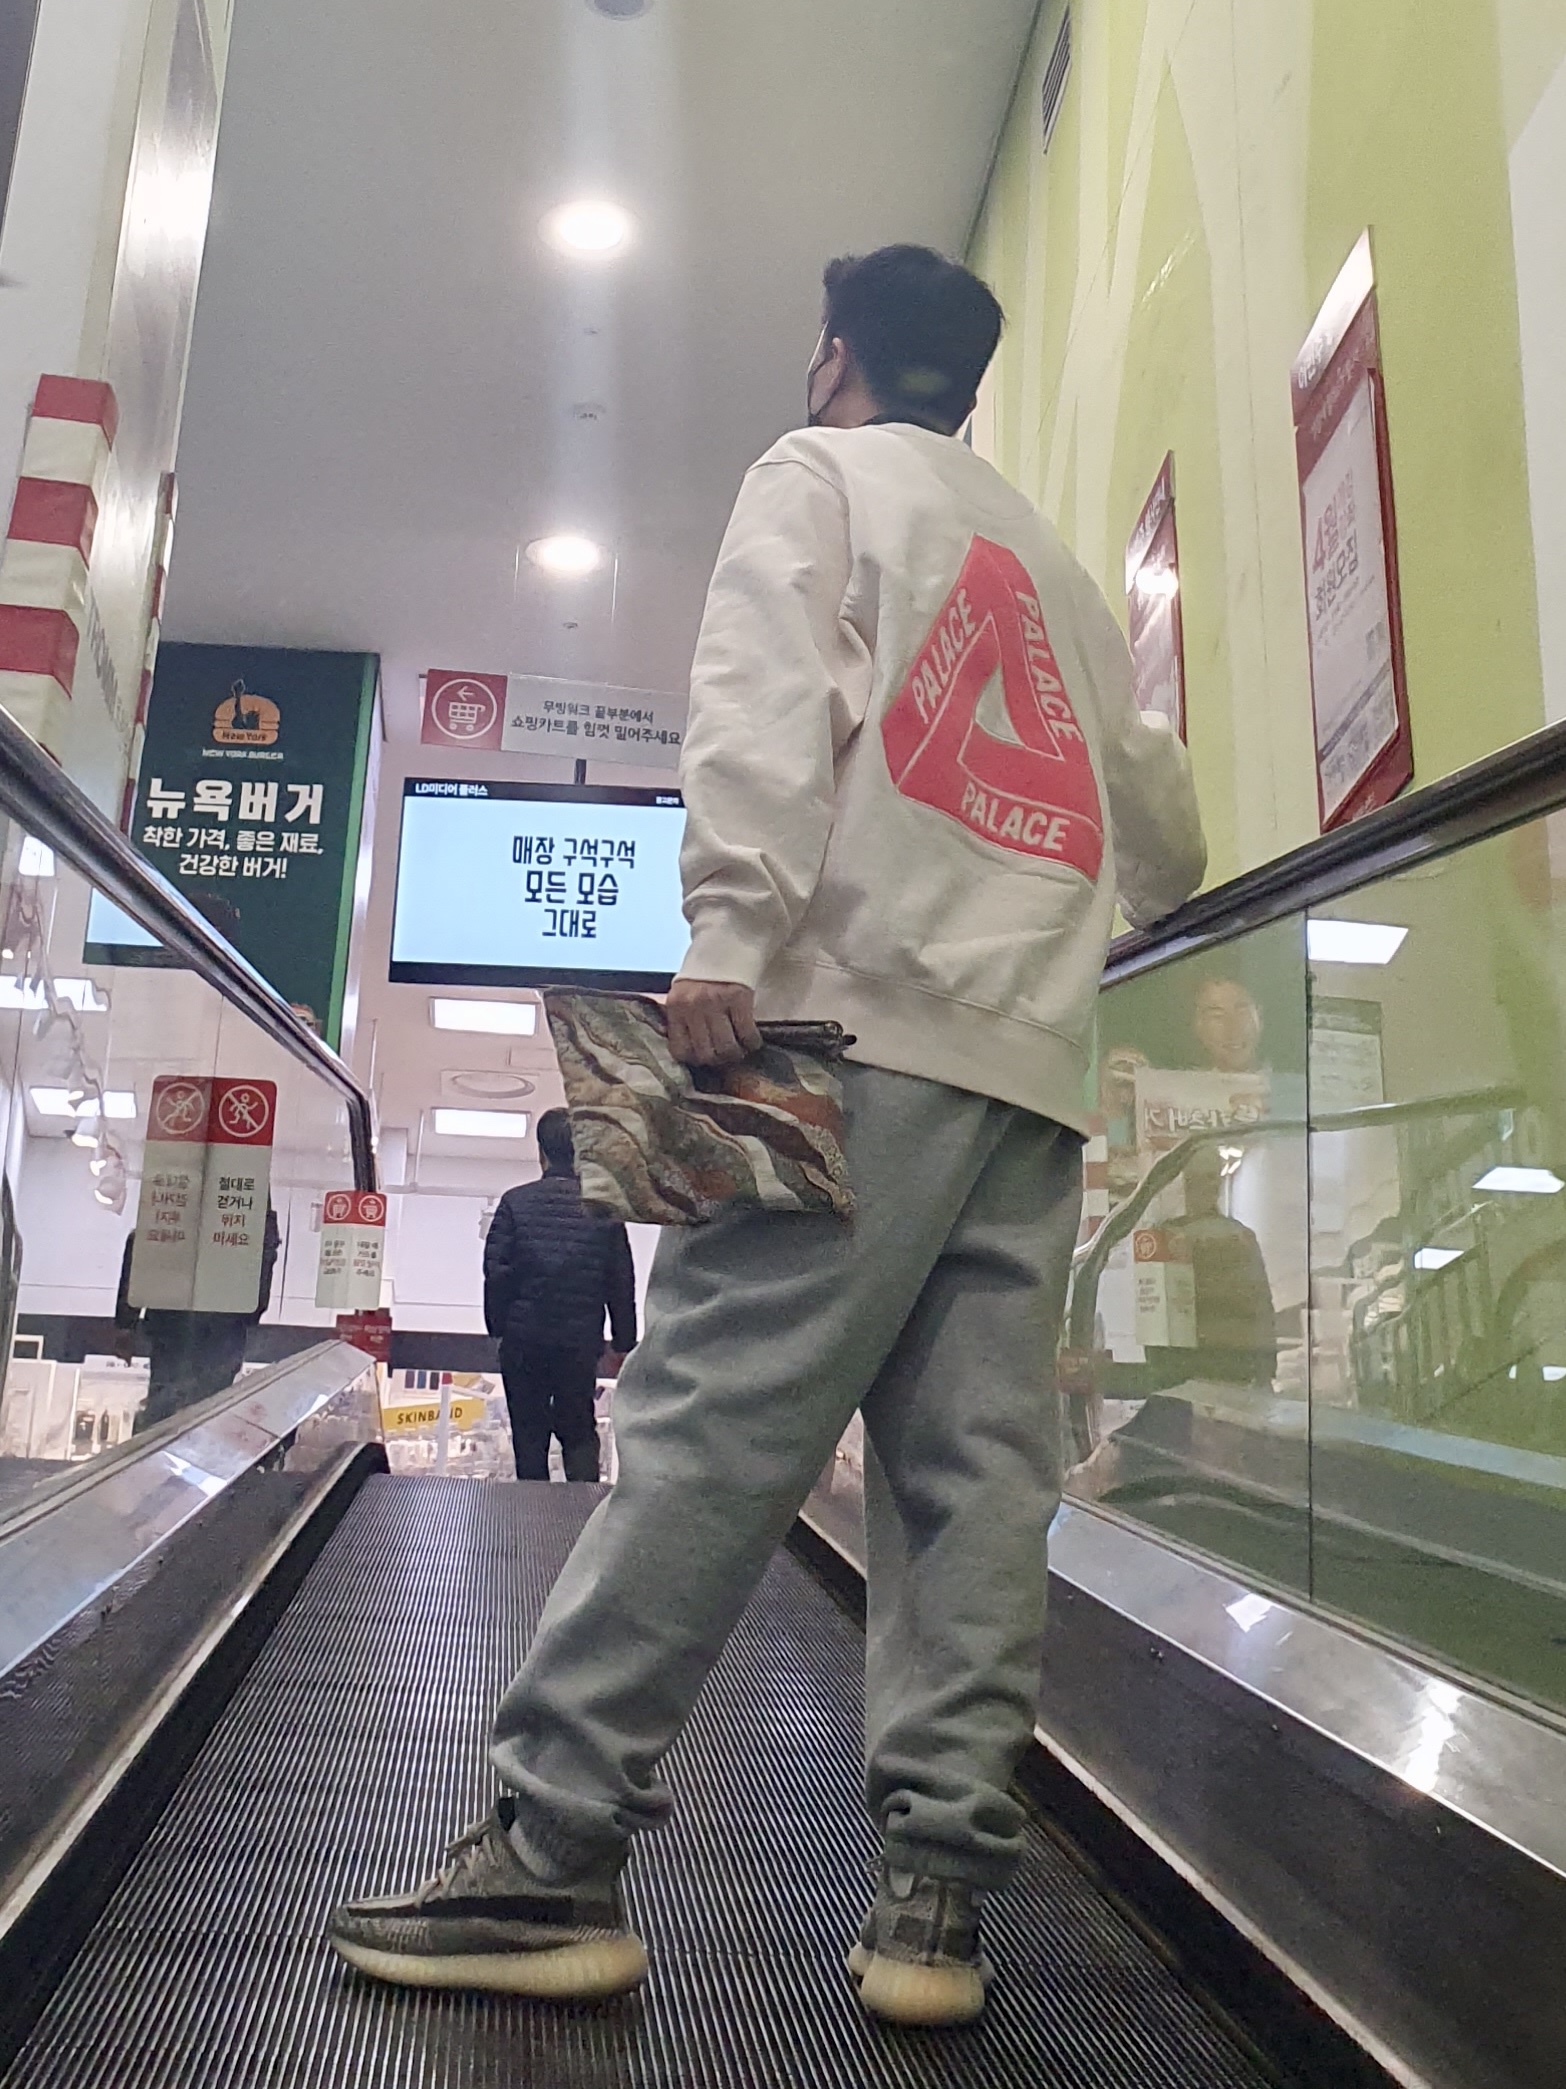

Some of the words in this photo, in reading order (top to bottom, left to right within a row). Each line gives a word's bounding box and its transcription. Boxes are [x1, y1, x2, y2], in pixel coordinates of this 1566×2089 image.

[912, 589, 975, 724] PALACE
[1016, 591, 1083, 742] PALACE
[543, 700, 590, 716] 무빙워크
[595, 705, 654, 724] 끝부분에서
[511, 715, 579, 736] 쇼핑카트를
[584, 720, 610, 739] 힘껏
[614, 725, 681, 745] 밀어주세요
[147, 778, 324, 824] 뉴욕버거
[415, 783, 458, 796] LD미디어
[459, 784, 488, 797] 플러스
[961, 782, 1071, 852] PALACE
[143, 826, 183, 849] 착한
[187, 828, 230, 851] 가격,
[236, 830, 275, 853] 좋은
[279, 831, 324, 855] 재료,
[512, 835, 555, 865] 매장
[563, 837, 636, 869] 구석구석
[179, 854, 238, 877] 건강한
[242, 857, 287, 879] 버거!
[524, 870, 567, 904] 모든
[576, 872, 619, 906] 모습
[542, 909, 597, 938] 그대로
[218, 1176, 255, 1191] 절대로
[217, 1195, 253, 1210] 걷거나
[221, 1214, 245, 1228] 뛰지
[212, 1231, 249, 1247] 마세요
[397, 1407, 463, 1425] SKINBD
